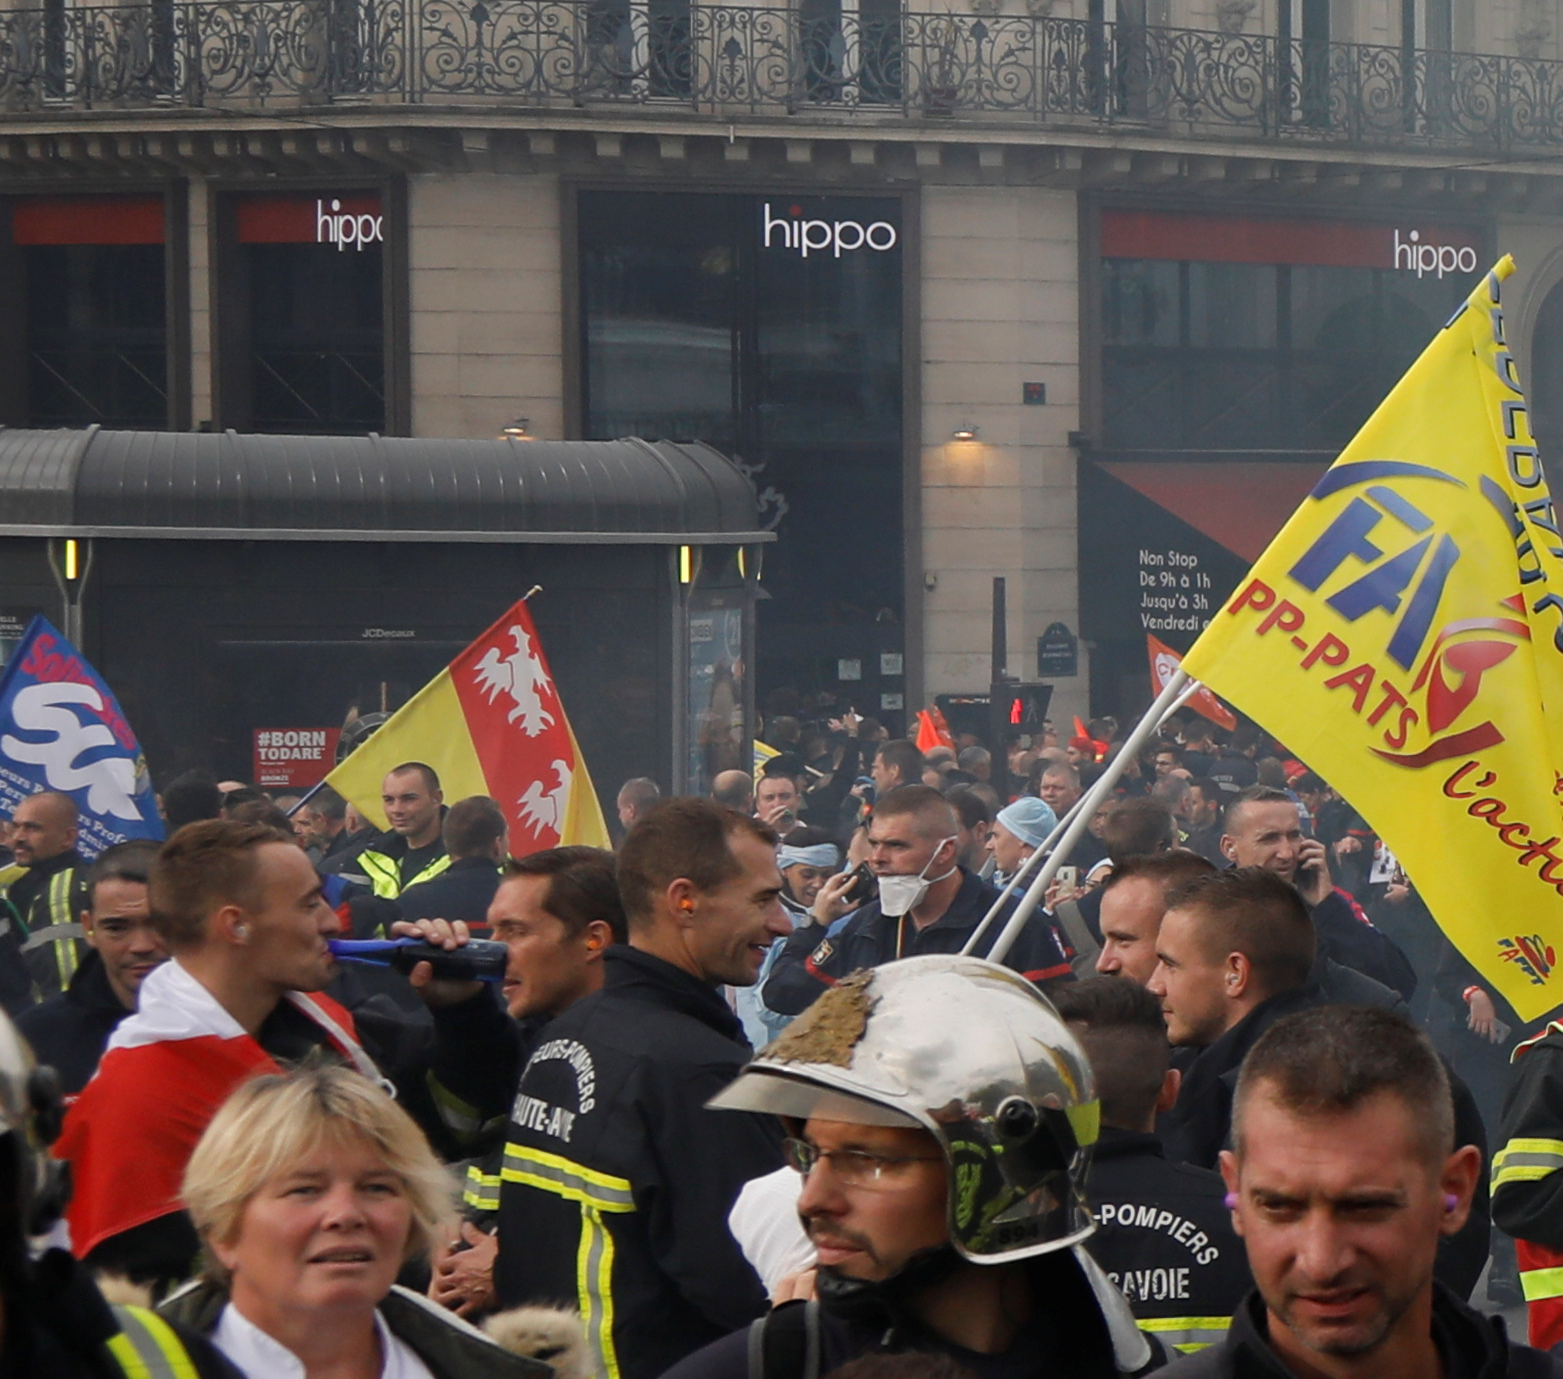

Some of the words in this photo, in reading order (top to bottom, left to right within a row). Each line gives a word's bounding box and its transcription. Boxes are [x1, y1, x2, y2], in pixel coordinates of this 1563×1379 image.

[764, 203, 897, 258] hippo
[1394, 229, 1476, 279] hippo
[1140, 550, 1163, 566] Non
[1167, 551, 1198, 569] Stop
[1140, 571, 1156, 587] De
[1159, 572, 1176, 588] 9h
[1181, 573, 1189, 589] à
[1196, 573, 1211, 590] 1h
[1140, 593, 1188, 612] Jusqu'à
[1193, 594, 1209, 610] 3h
[1141, 614, 1199, 631] Vendredi
[361, 628, 416, 639] JCDecaux
[1227, 577, 1420, 750] PP-PATS
[257, 731, 326, 747] #BORN
[1093, 1203, 1219, 1266] -POMPIERS
